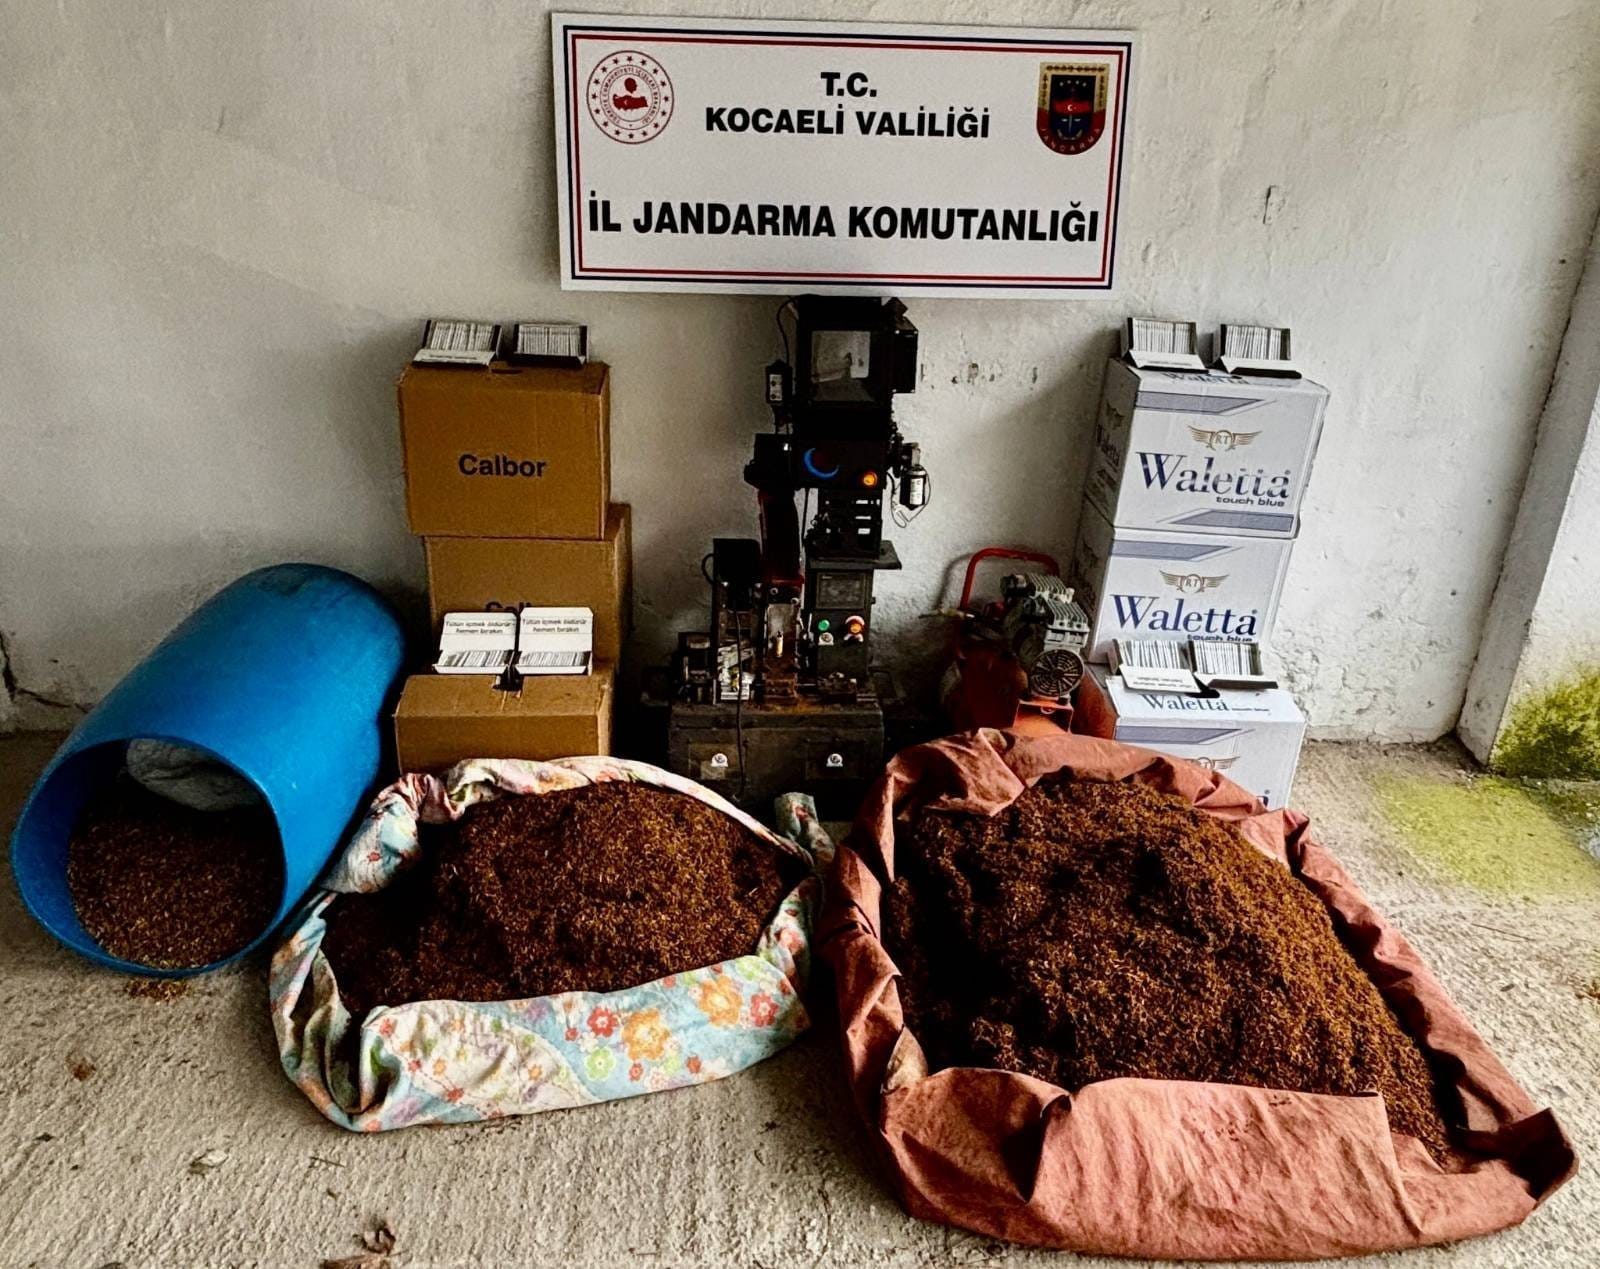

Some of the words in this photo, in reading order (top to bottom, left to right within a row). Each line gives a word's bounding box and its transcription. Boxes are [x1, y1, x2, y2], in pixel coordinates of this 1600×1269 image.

[820, 71, 878, 98] T.C.
[705, 103, 845, 135] KOCAELİ
[855, 105, 990, 139] VALİLİĞİ
[588, 190, 622, 232] İL
[633, 201, 836, 237] JANDARMA
[848, 200, 1099, 242] KOMUTANLIĞI
[458, 453, 547, 478] Calbor
[1216, 496, 1254, 505] touch
[1257, 497, 1285, 507] blue
[1109, 594, 1257, 636] Waletta
[1140, 693, 1229, 711] Waletta
